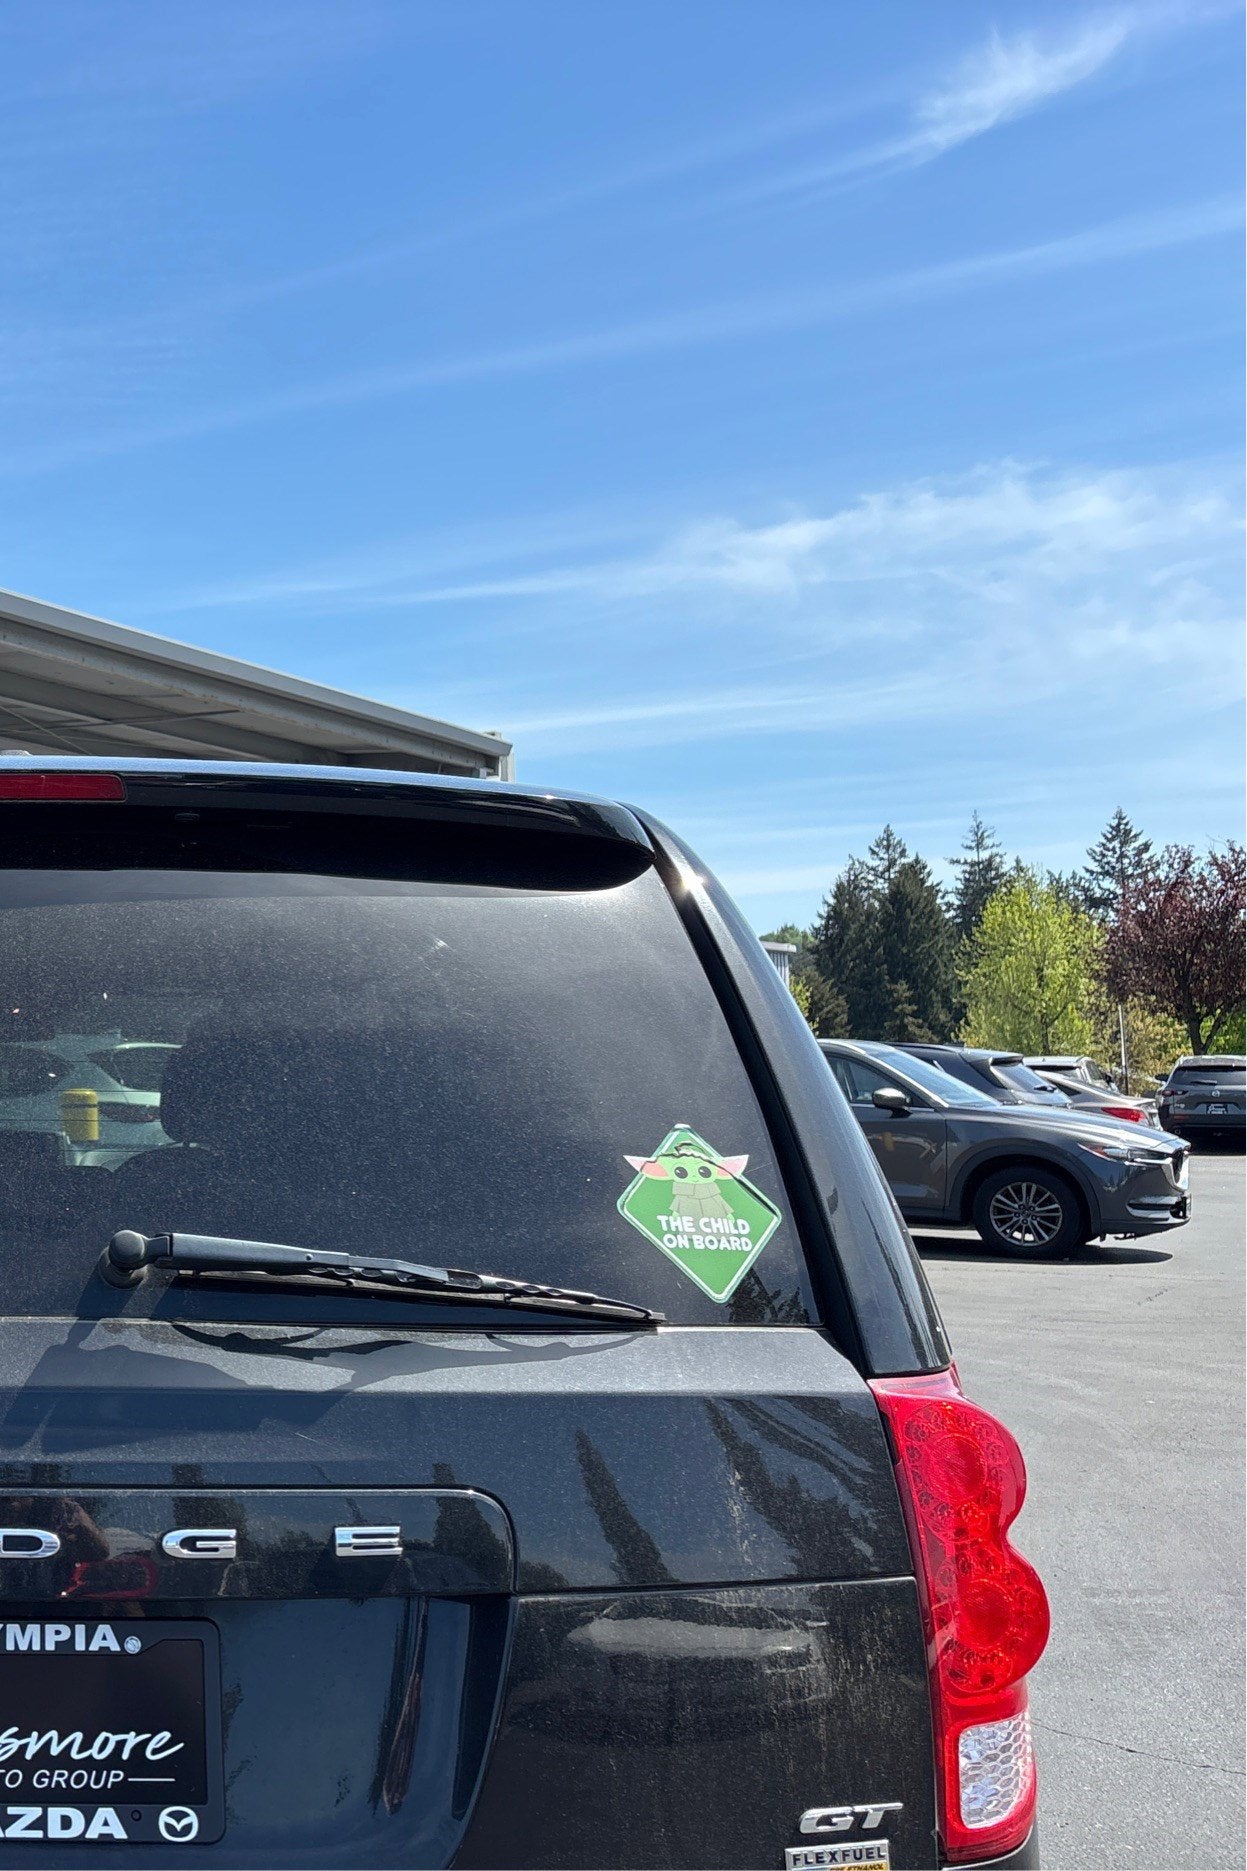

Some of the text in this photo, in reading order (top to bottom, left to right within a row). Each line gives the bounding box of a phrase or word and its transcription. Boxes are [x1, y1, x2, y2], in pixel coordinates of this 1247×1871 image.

[657, 1215, 750, 1235] THE CHILD
[663, 1234, 752, 1252] ON BOARD
[33, 1770, 125, 1789] GROUP
[799, 1802, 904, 1834] GT
[792, 1847, 886, 1866] FLEXFUEL
